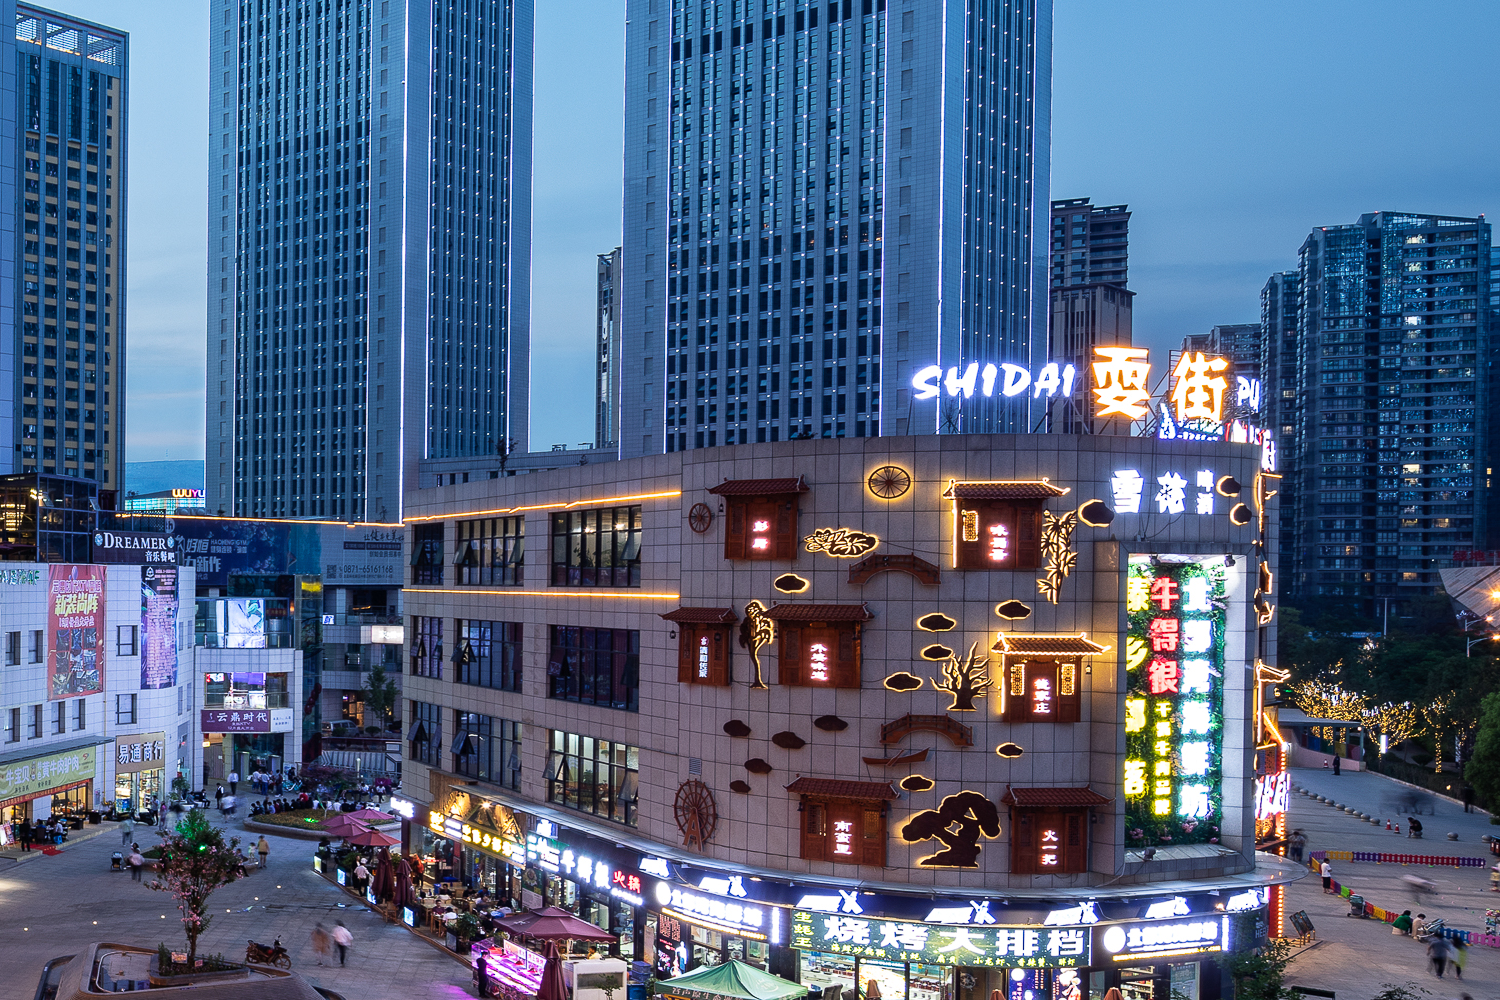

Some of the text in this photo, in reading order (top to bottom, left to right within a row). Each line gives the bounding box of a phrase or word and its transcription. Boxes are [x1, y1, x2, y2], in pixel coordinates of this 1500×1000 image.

[911, 362, 1076, 400] SHIDAI
[1091, 346, 1231, 422] 耍街
[1110, 469, 1188, 515] 雪花
[103, 532, 167, 550] DREAMER
[144, 550, 176, 563] 音乐餐吧
[343, 565, 394, 574] 0871-65161168
[216, 711, 268, 723] 云鼎时代
[118, 740, 164, 765] 易通商行
[5, 765, 30, 787] 牛宝贝
[1041, 829, 1059, 866] 火一把
[823, 915, 1085, 957] 烧烤大排档
